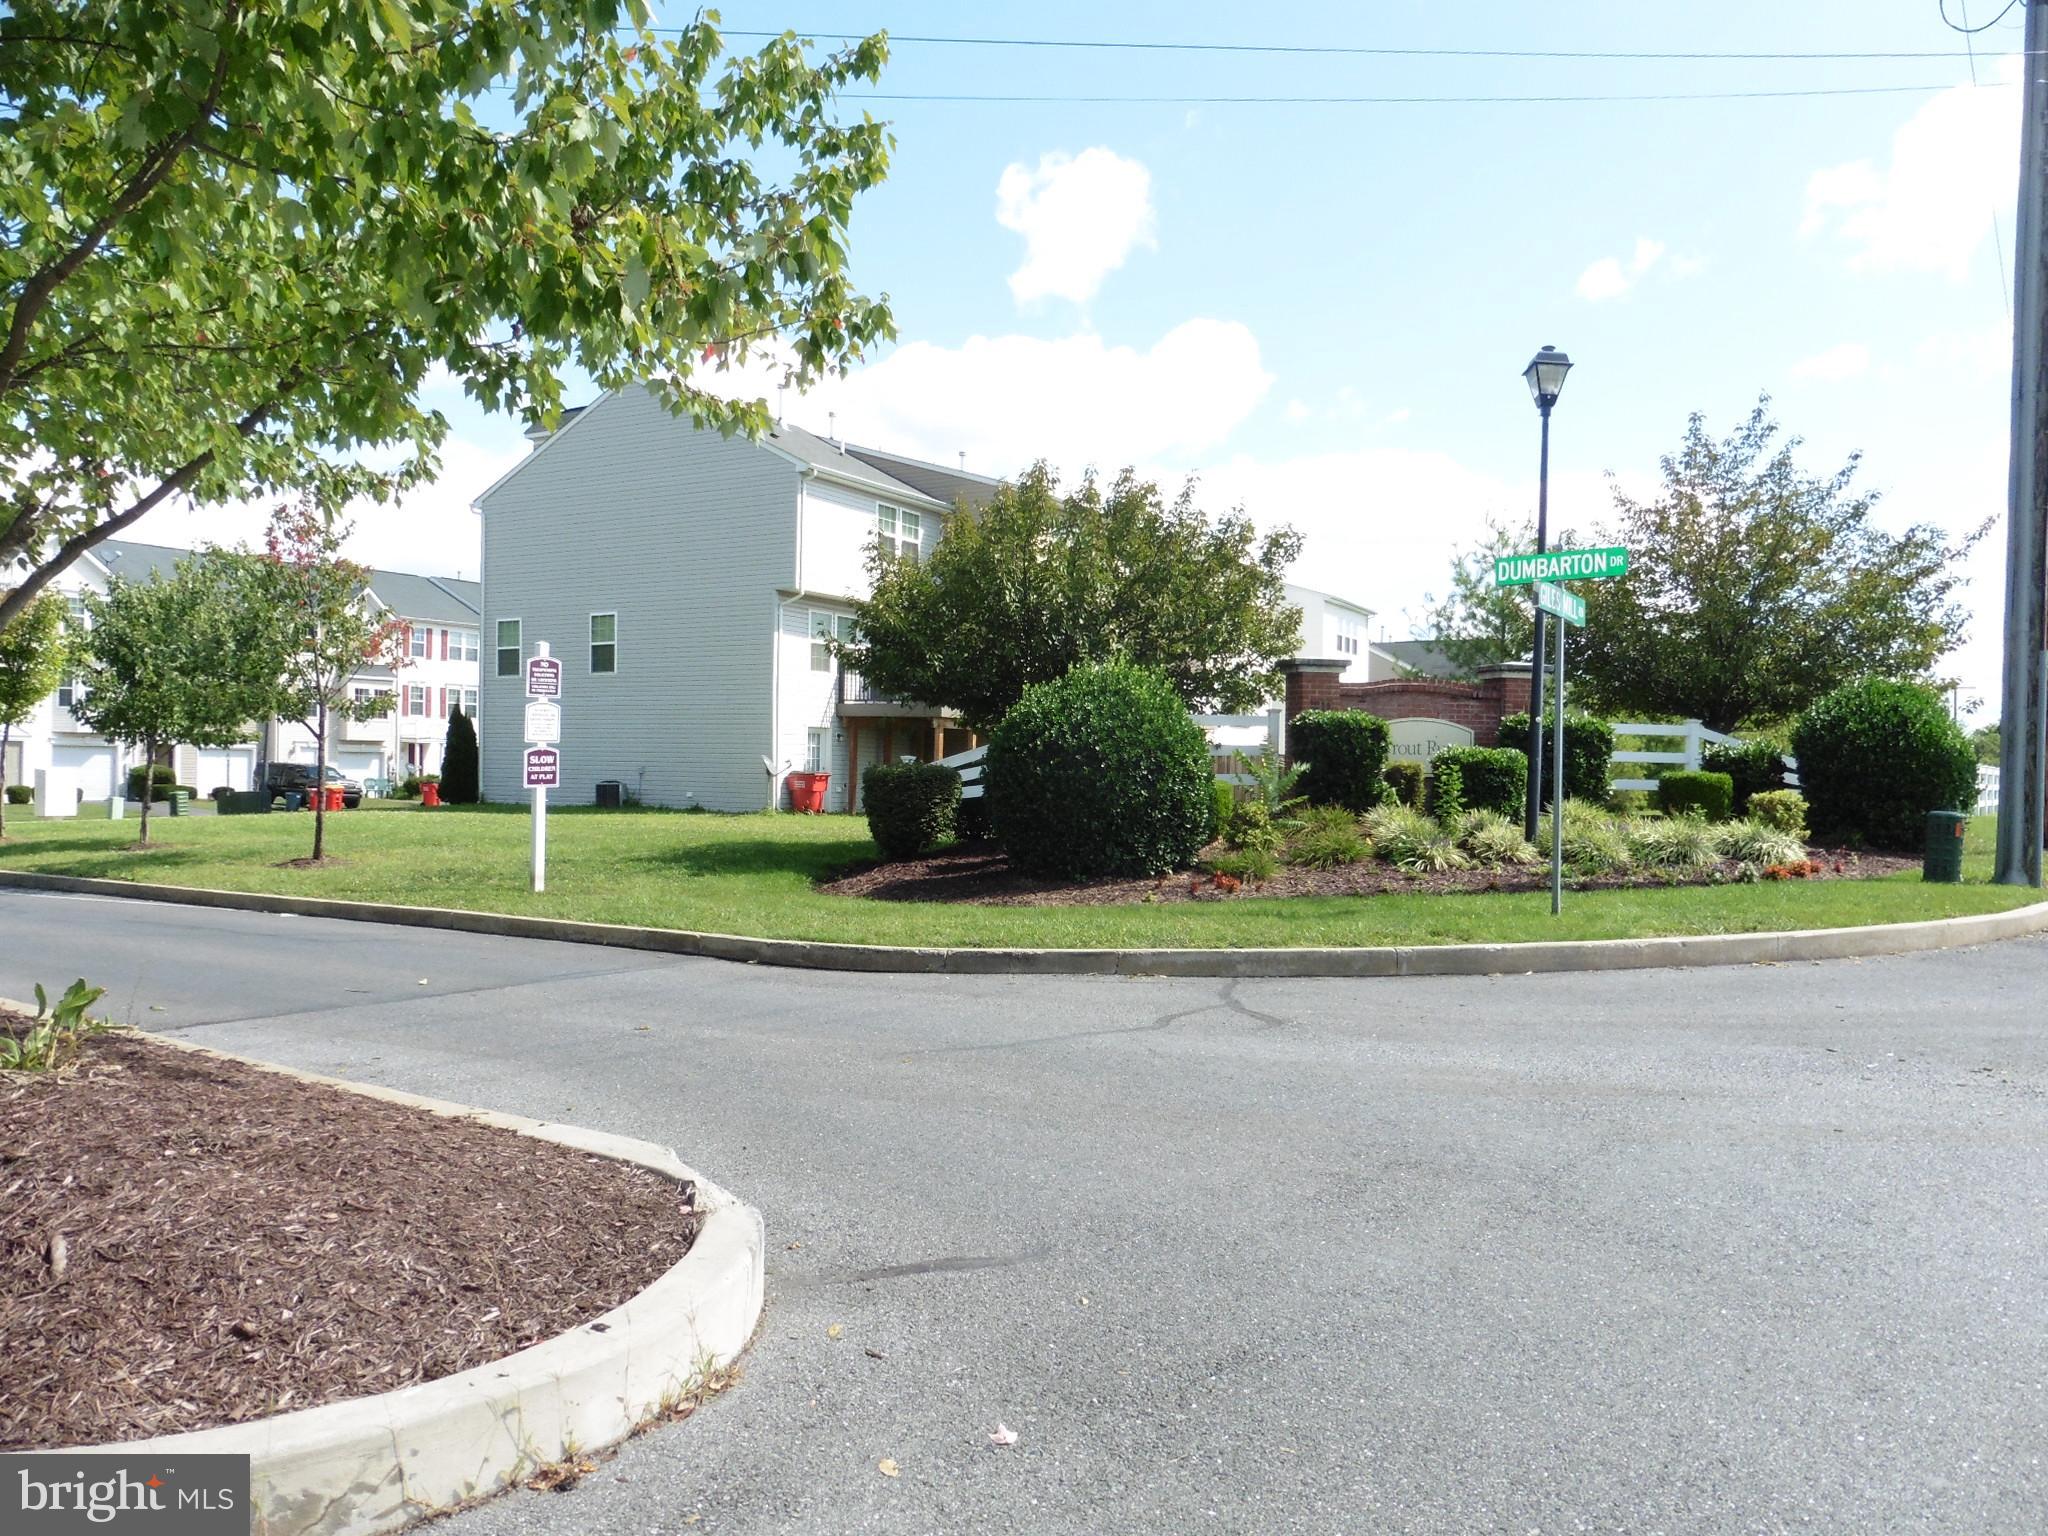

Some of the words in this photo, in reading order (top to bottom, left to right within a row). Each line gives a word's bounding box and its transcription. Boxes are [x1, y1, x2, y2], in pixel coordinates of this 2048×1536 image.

[1498, 552, 1607, 582] DUMBARTON
[1609, 555, 1624, 567] DR
[1389, 743, 1422, 756] rout
[529, 755, 555, 764] SLOW
